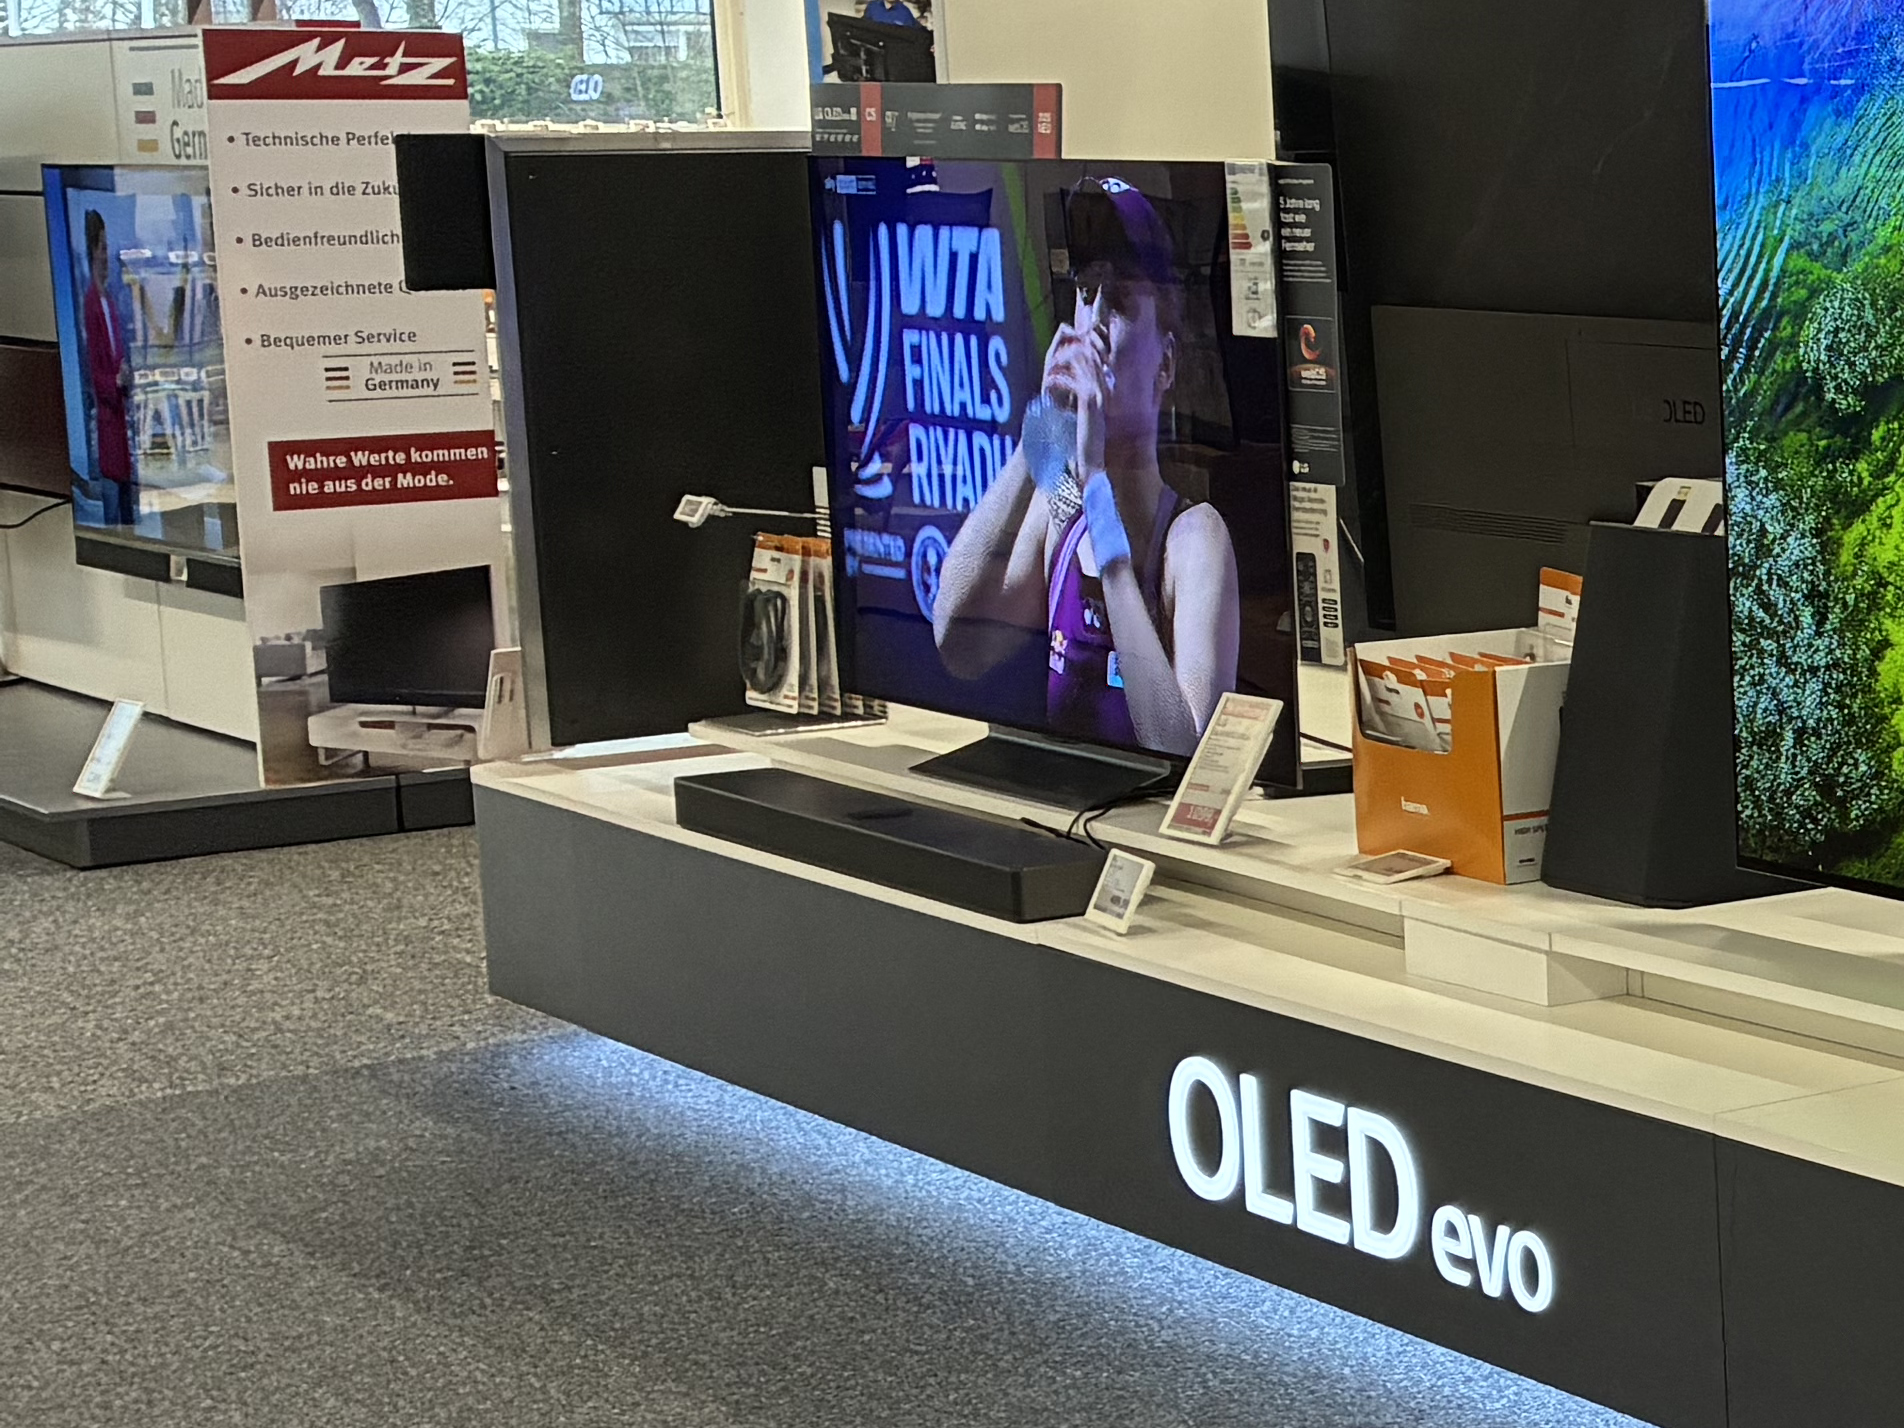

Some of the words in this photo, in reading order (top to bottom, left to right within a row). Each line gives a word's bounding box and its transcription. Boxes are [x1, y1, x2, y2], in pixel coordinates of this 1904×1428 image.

[210, 37, 458, 85] Metz
[241, 131, 340, 147] Technische
[247, 182, 302, 198] Sicher
[308, 182, 323, 196] in
[330, 181, 355, 196] die
[251, 230, 400, 248] Bedienfreundlich
[896, 222, 1005, 322] WTA
[255, 281, 393, 300] Ausgezeichnete
[260, 333, 348, 350] Bequemer
[355, 329, 417, 344] Service
[370, 359, 413, 375] Made
[418, 358, 432, 372] in
[902, 328, 1012, 423] FINALS
[365, 375, 440, 392] Germany
[286, 453, 347, 471] Wahre
[351, 450, 405, 468] Werte
[410, 446, 488, 463] kommen
[289, 478, 318, 495] nie
[324, 479, 357, 493] aus
[362, 474, 391, 490] der
[397, 470, 453, 489] Mode.
[1168, 1055, 1419, 1260] OLED
[1431, 1204, 1552, 1313] evo
